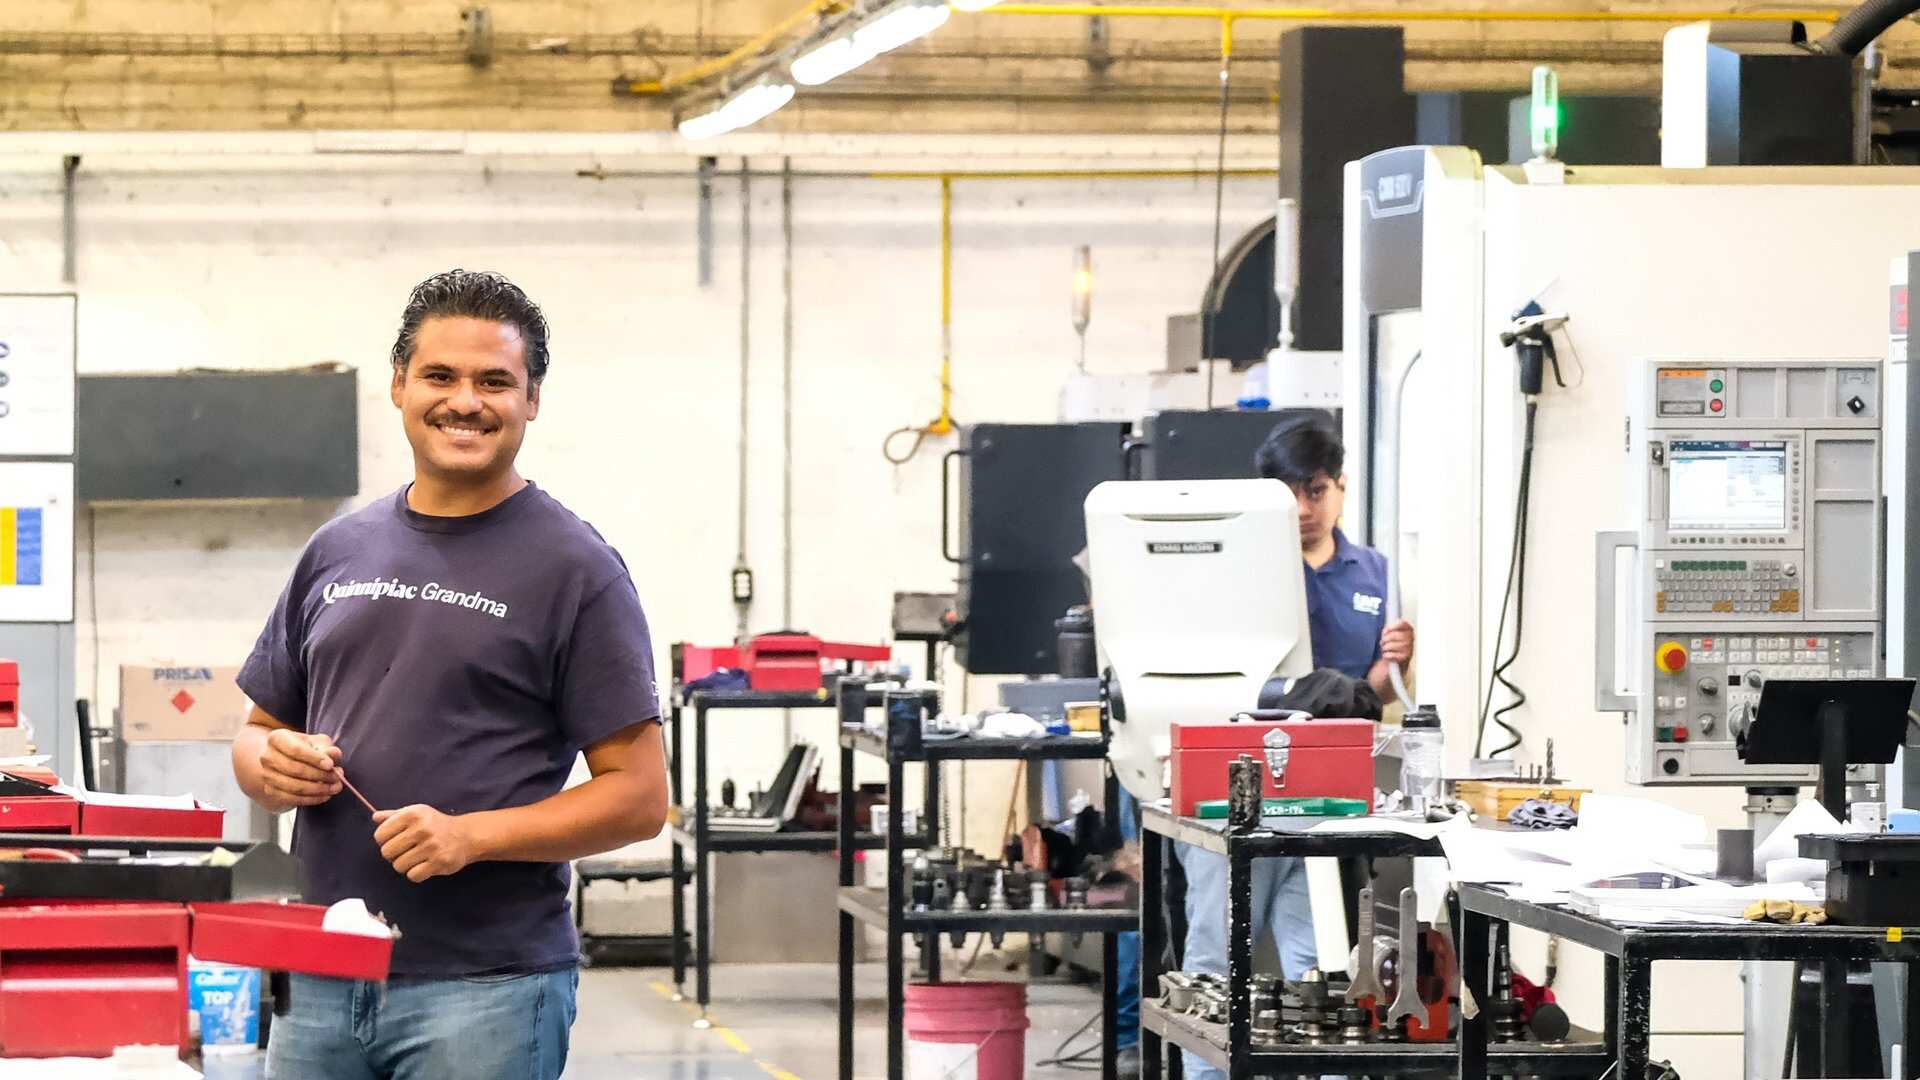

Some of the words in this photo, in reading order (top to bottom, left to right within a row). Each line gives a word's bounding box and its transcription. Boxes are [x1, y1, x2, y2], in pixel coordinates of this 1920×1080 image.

[322, 577, 418, 604] Quinnipiac
[420, 582, 508, 618] Grandma
[153, 667, 213, 681] PRISA
[202, 991, 234, 1005] TOP
